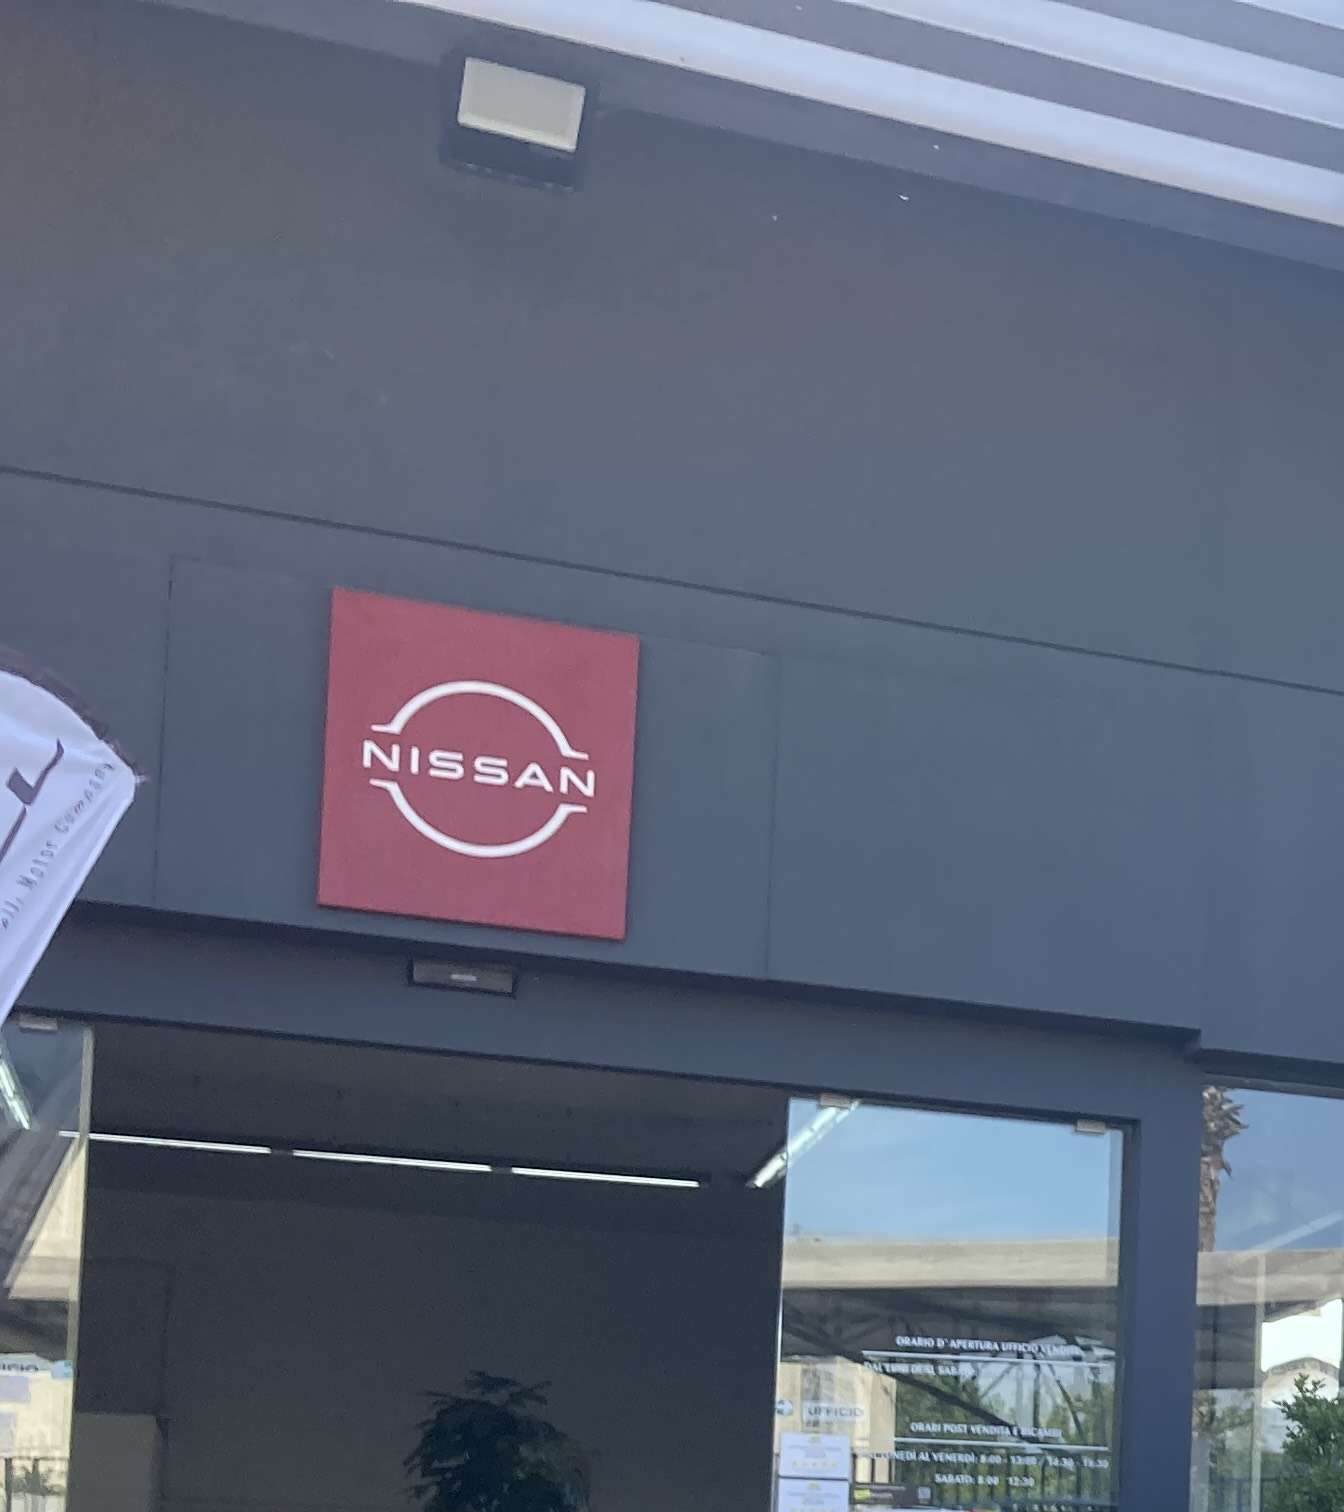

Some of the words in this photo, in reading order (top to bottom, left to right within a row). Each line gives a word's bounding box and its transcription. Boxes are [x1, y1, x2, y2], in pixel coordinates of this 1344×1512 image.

[362, 739, 595, 798] NISSAN
[896, 1336, 934, 1348] ORARIO
[950, 1338, 999, 1351] APERTURA
[807, 1406, 864, 1417] UFFICIO
[910, 1422, 941, 1433] ORARI
[943, 1424, 967, 1434] POST
